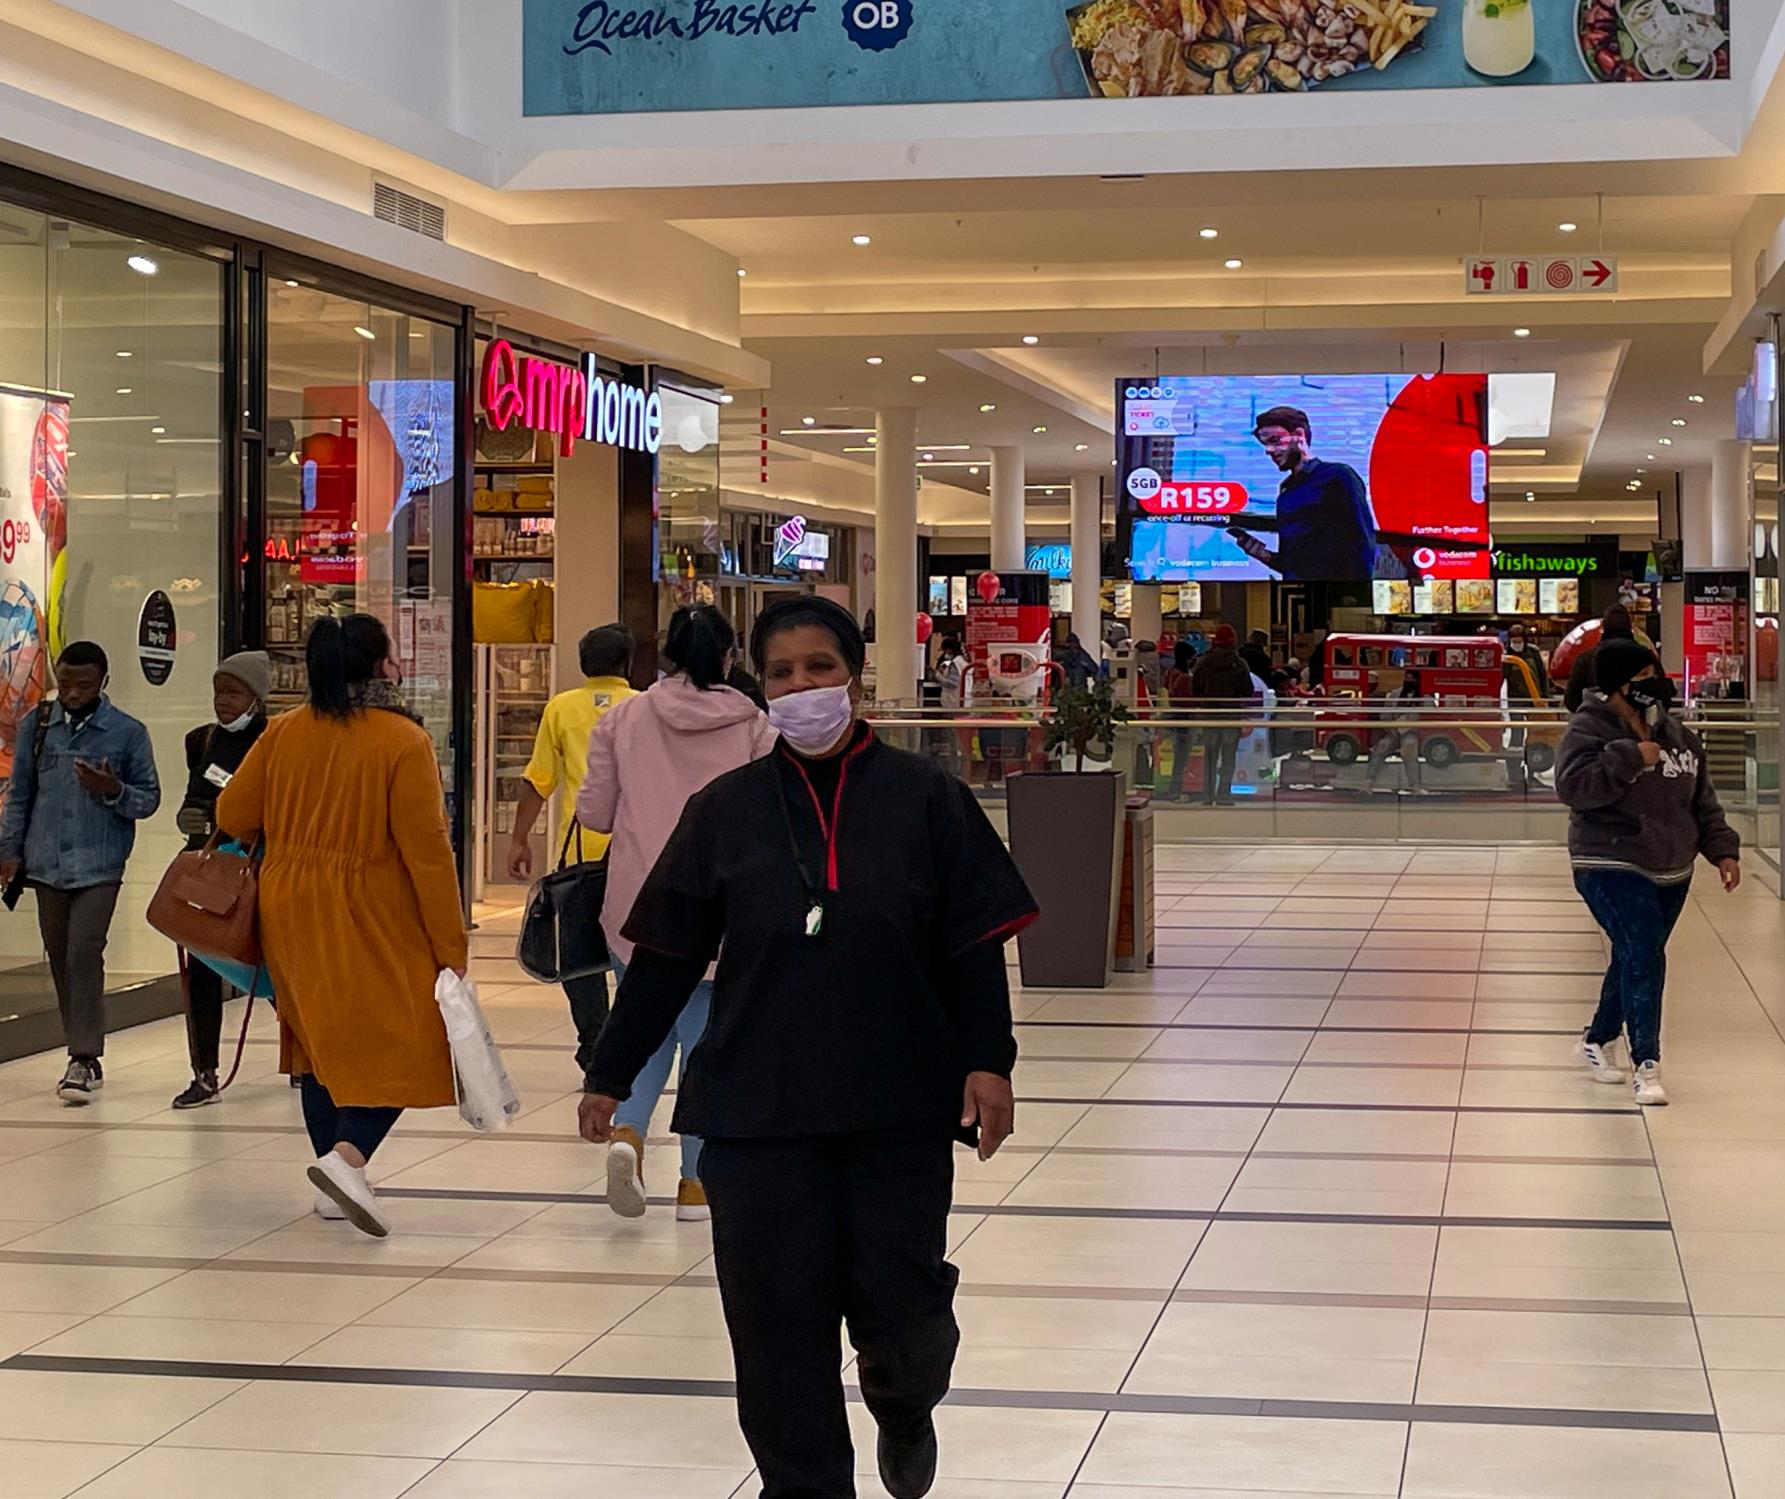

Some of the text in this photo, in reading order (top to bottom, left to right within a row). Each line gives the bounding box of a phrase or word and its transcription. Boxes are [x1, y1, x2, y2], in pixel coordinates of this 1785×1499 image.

[853, 1, 900, 30] OB
[563, 0, 817, 56] Ocean Basket
[1131, 478, 1158, 489] 5GB
[1160, 486, 1231, 509] R159
[1439, 551, 1477, 559] vodacom
[1498, 552, 1598, 575] fishaways
